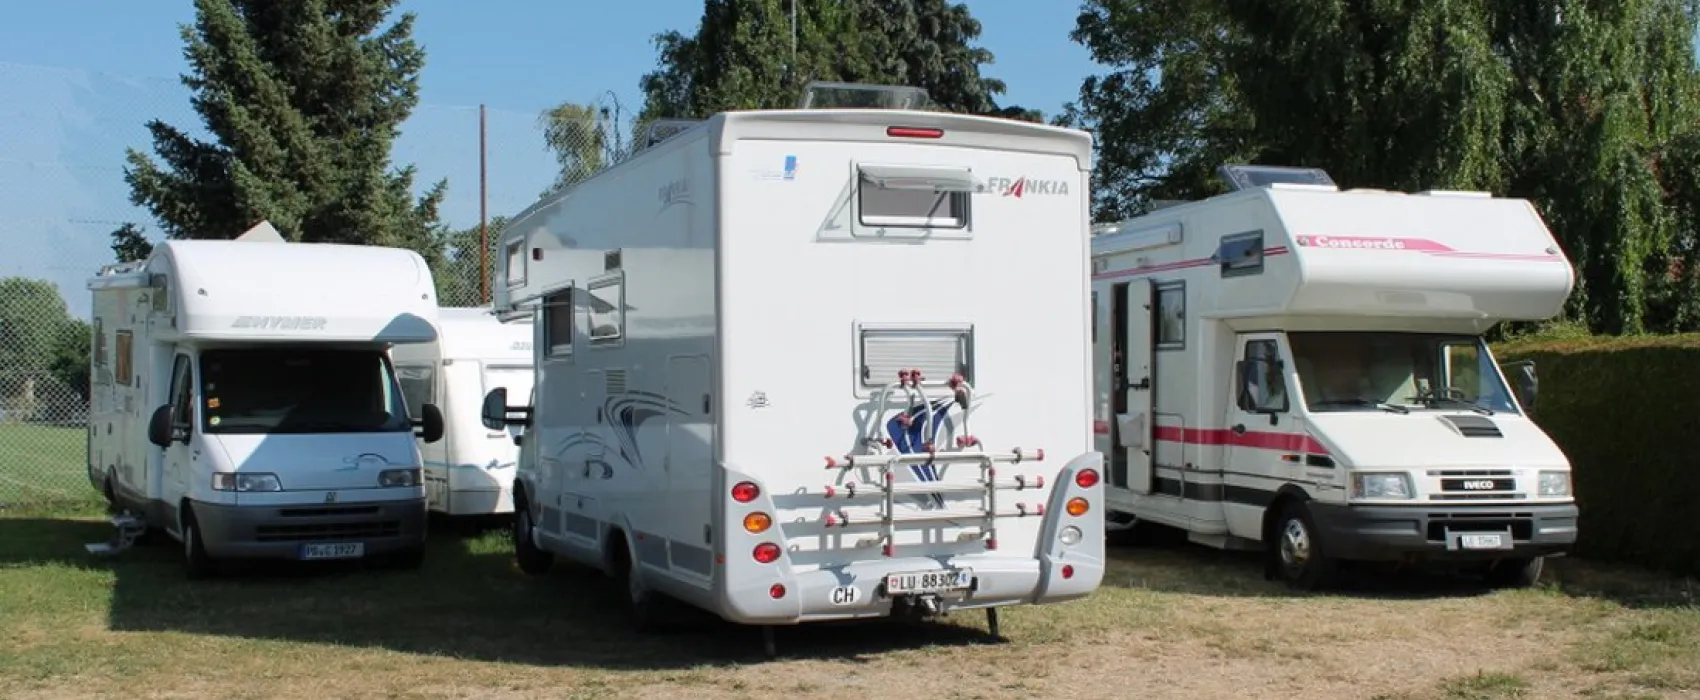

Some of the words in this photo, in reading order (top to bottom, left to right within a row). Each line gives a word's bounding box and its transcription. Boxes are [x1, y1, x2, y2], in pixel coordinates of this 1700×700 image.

[988, 175, 1069, 198] FRANKIA
[1315, 235, 1405, 249] Concorde
[249, 315, 328, 330] HYMER
[1464, 480, 1494, 490] IVECO
[901, 577, 916, 589] LU
[922, 573, 959, 588] 88302
[833, 587, 854, 603] CH
